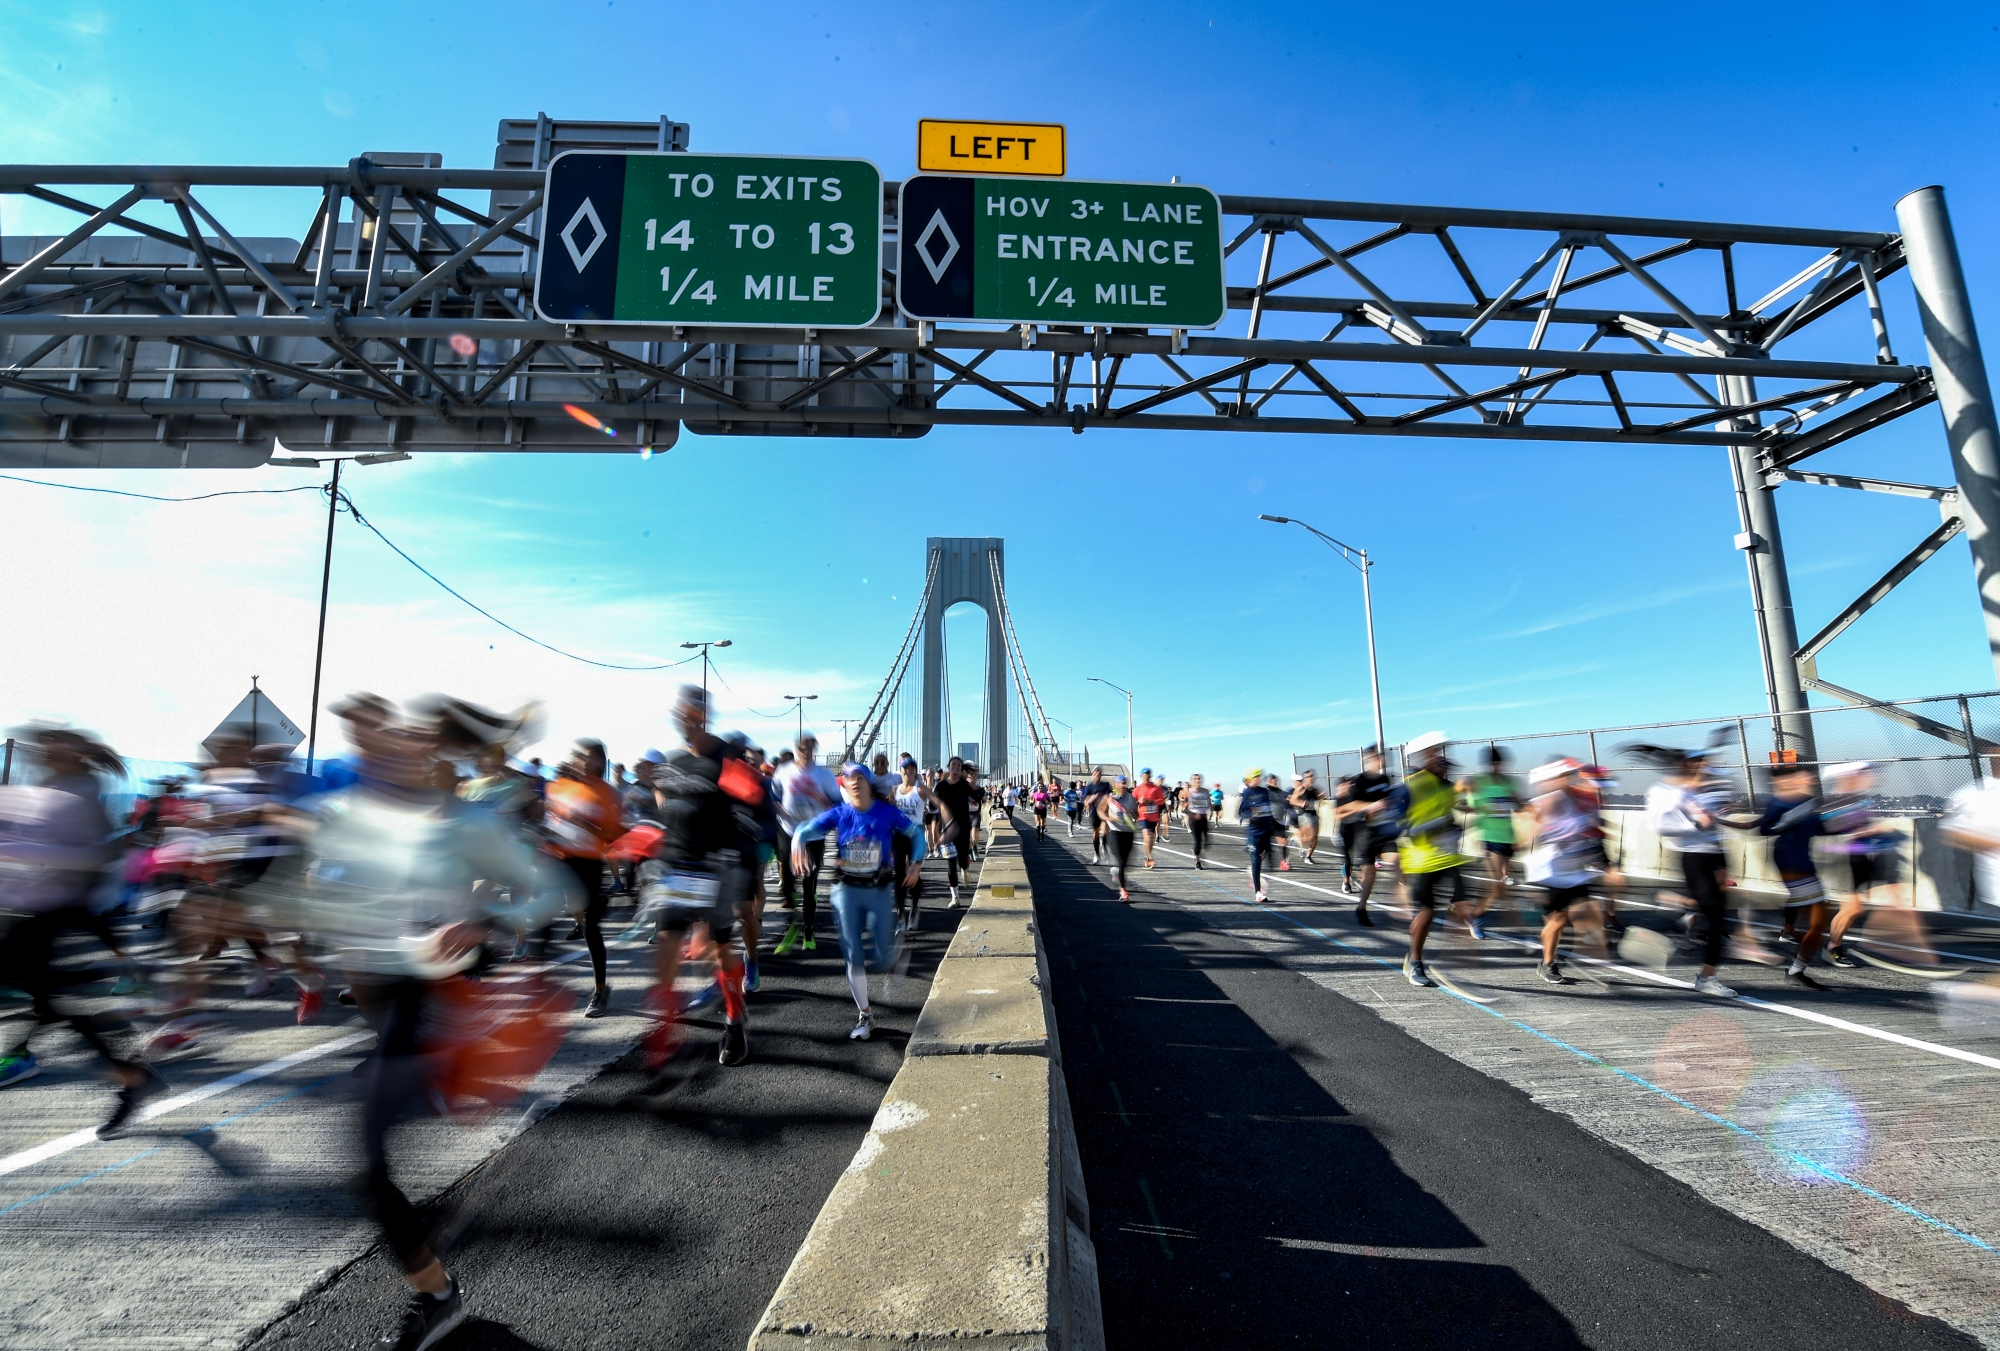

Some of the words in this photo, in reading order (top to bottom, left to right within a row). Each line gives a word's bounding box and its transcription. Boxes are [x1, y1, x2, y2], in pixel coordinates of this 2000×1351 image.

[950, 135, 1037, 161] LEFT
[668, 173, 714, 198] TO
[736, 175, 842, 202] EXITS
[987, 196, 1050, 218] HOV
[1070, 199, 1104, 220] 3+
[1123, 202, 1203, 225] LANE
[644, 218, 695, 252] 14
[729, 224, 775, 249] TO
[808, 222, 855, 255] 13
[997, 234, 1194, 265] ENTRANCE
[660, 266, 717, 306] 1/4
[744, 275, 834, 302] MILE
[1028, 276, 1076, 308] 1/4
[1095, 283, 1167, 306] MILE
